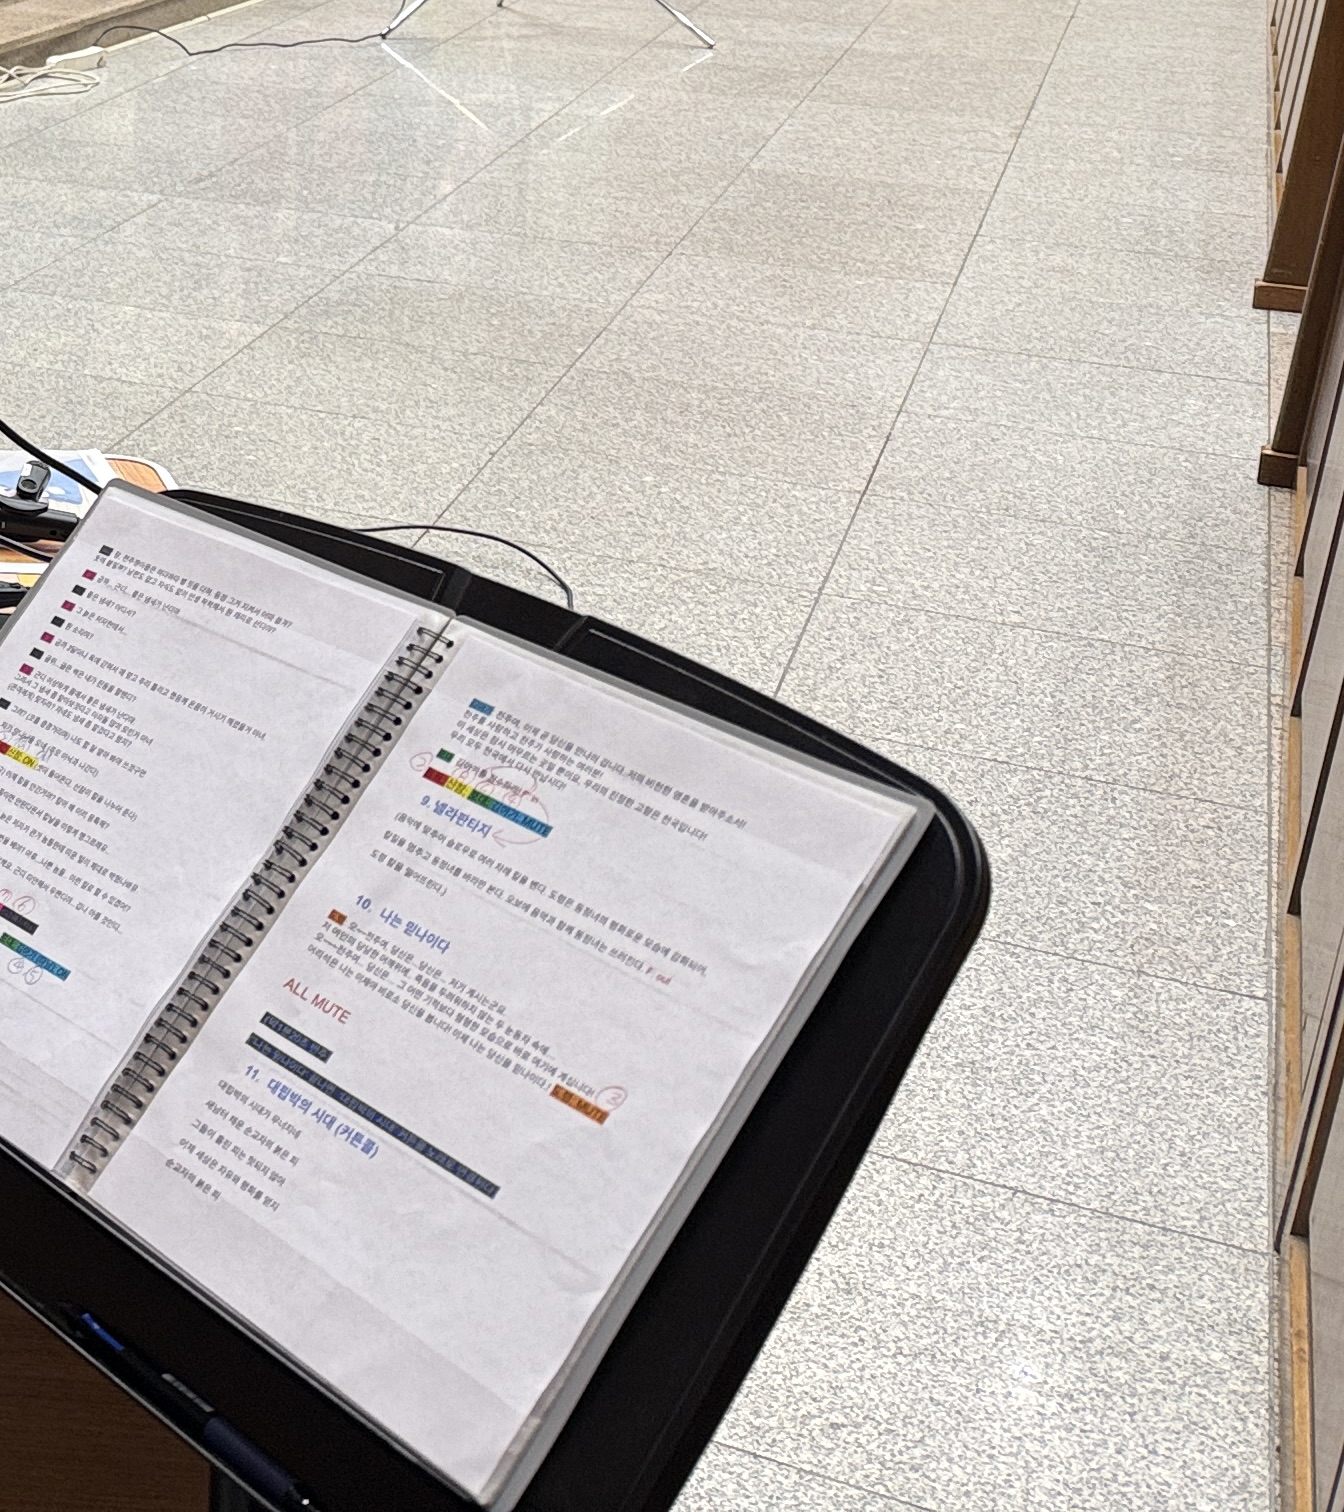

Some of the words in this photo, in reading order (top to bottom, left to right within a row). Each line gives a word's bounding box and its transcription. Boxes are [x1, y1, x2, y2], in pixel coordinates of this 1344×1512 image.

[419, 794, 433, 808] 9.
[354, 893, 374, 913] 10.
[377, 906, 404, 929] 나는
[281, 976, 311, 1001] ALL
[309, 992, 351, 1025] MUTE
[243, 1063, 262, 1083] 11.
[309, 1105, 338, 1131] 시대
